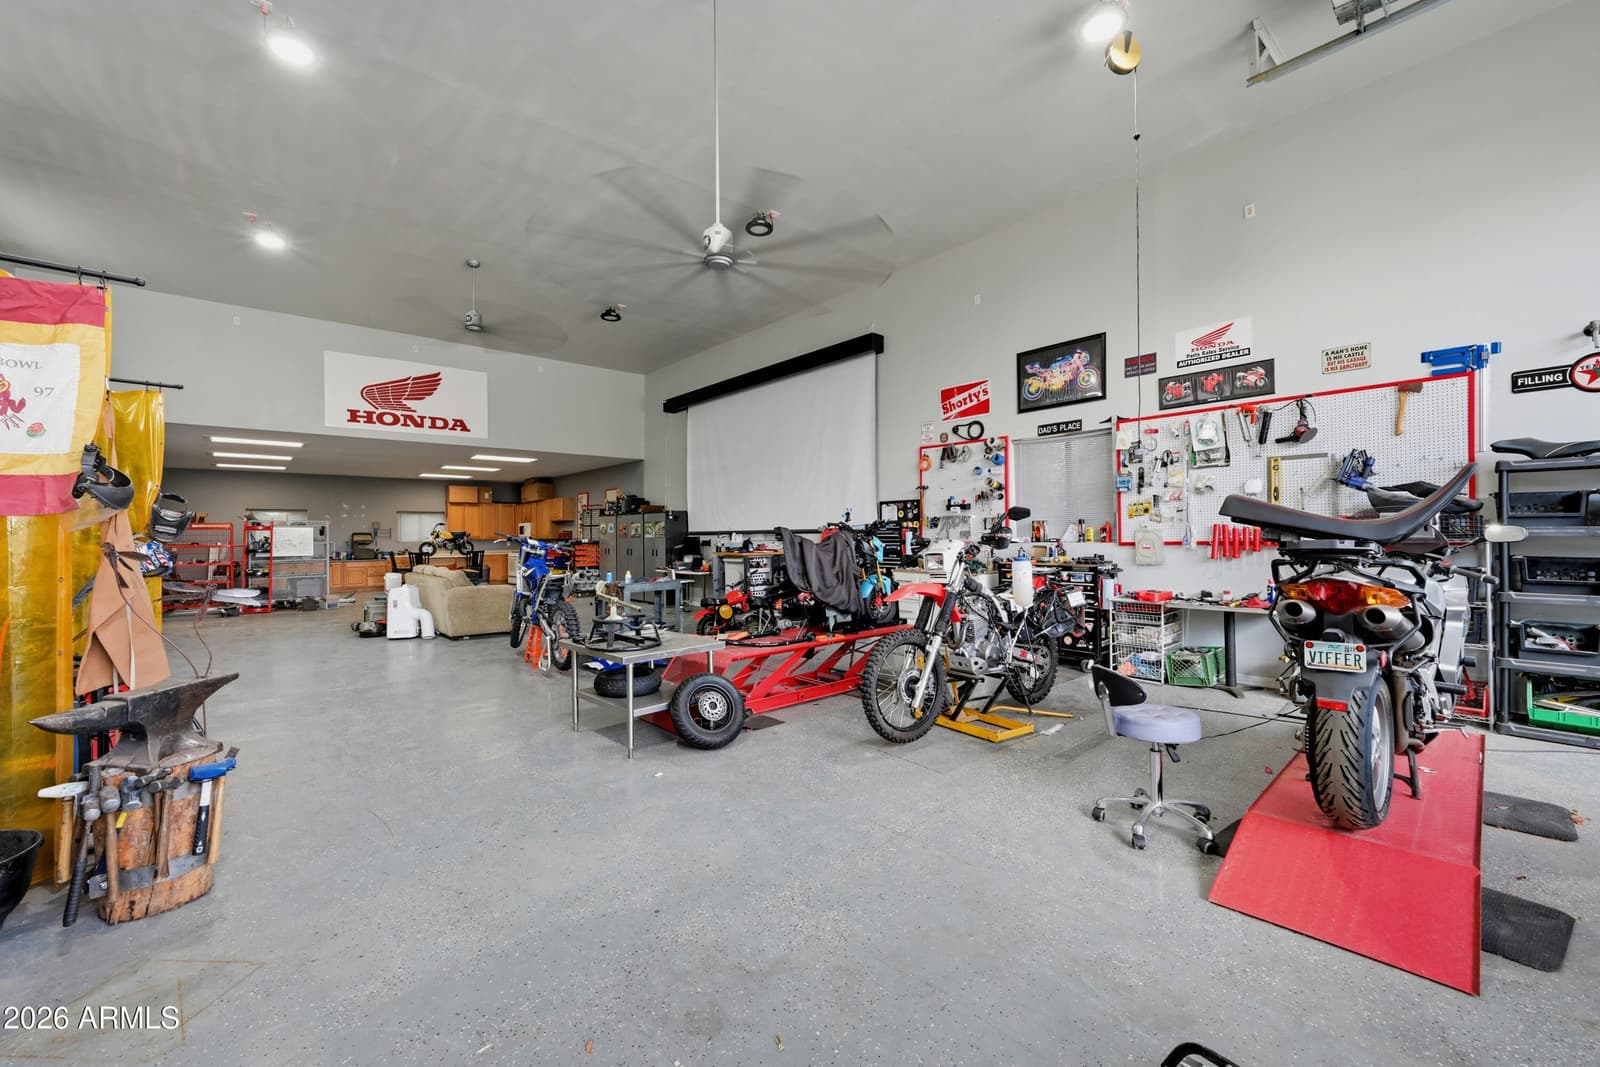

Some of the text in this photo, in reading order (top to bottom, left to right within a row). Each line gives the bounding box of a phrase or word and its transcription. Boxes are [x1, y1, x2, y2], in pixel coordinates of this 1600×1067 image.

[1191, 341, 1234, 352] HONDA
[1178, 349, 1249, 367] AUTHORIZED DEALER
[1518, 373, 1563, 386] FILLING
[33, 386, 56, 397] 97
[942, 387, 989, 415] Shorty's
[347, 409, 471, 432] HONDA
[1038, 422, 1081, 434] DAD'S PLACE
[1309, 650, 1362, 667] VIFFER
